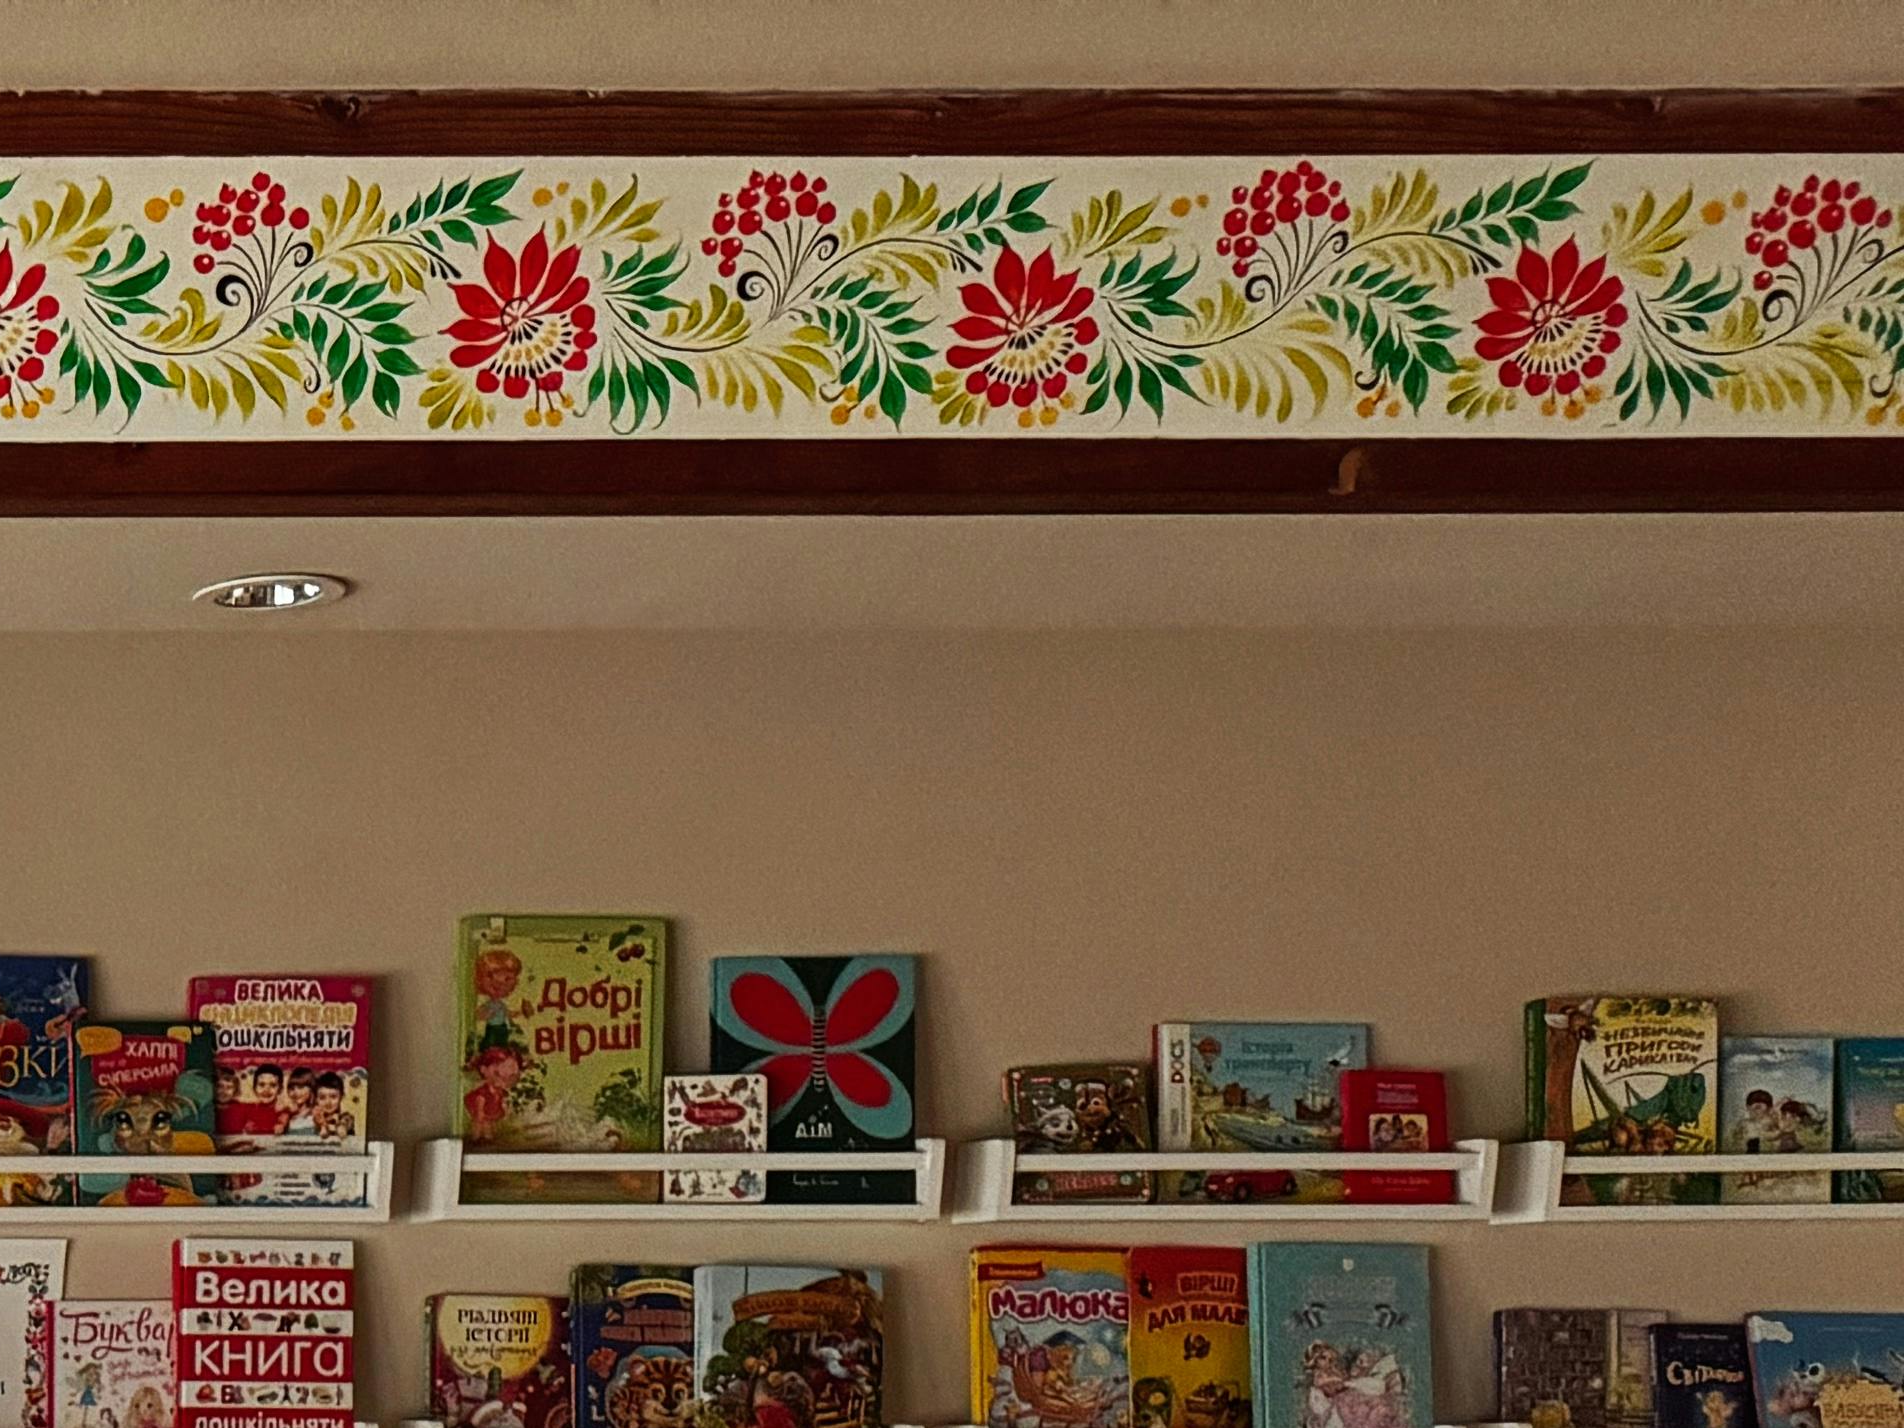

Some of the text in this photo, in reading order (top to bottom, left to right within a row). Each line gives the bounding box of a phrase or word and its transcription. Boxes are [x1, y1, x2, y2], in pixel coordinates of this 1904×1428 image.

[234, 981, 324, 1002] ВЕЛИКА
[536, 976, 644, 1012] Добрі
[217, 1028, 353, 1052] ОШКІЛЬНЯТИ
[533, 1016, 643, 1064] вірші
[195, 1271, 346, 1307] Велика
[1178, 1273, 1238, 1296] ВІРШІ
[1148, 1307, 1187, 1330] ДЛЯ
[195, 1340, 345, 1378] книга
